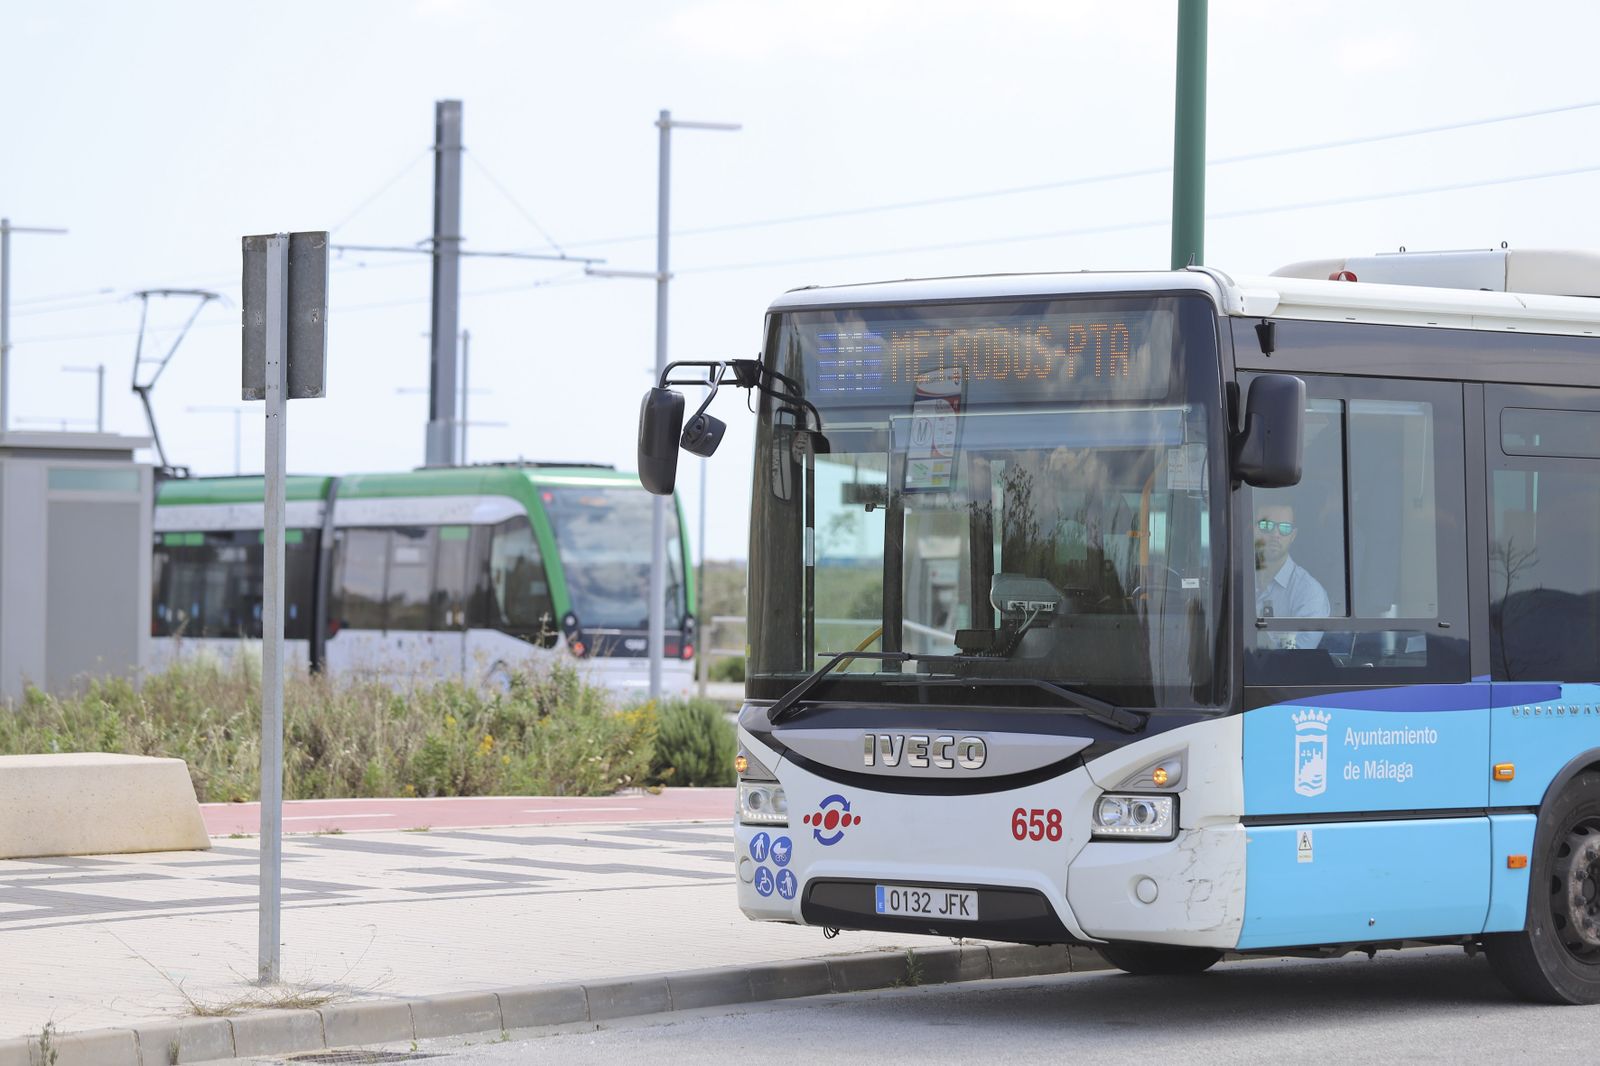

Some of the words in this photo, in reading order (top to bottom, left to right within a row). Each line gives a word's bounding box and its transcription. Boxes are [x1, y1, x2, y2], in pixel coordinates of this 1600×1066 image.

[1344, 725, 1438, 750] Ayuntamiento
[864, 733, 988, 770] IVECO
[1343, 761, 1360, 780] de
[1364, 759, 1413, 783] Málaga
[1011, 807, 1063, 842] 658
[890, 889, 931, 913] 0132
[939, 893, 970, 916] JFK
